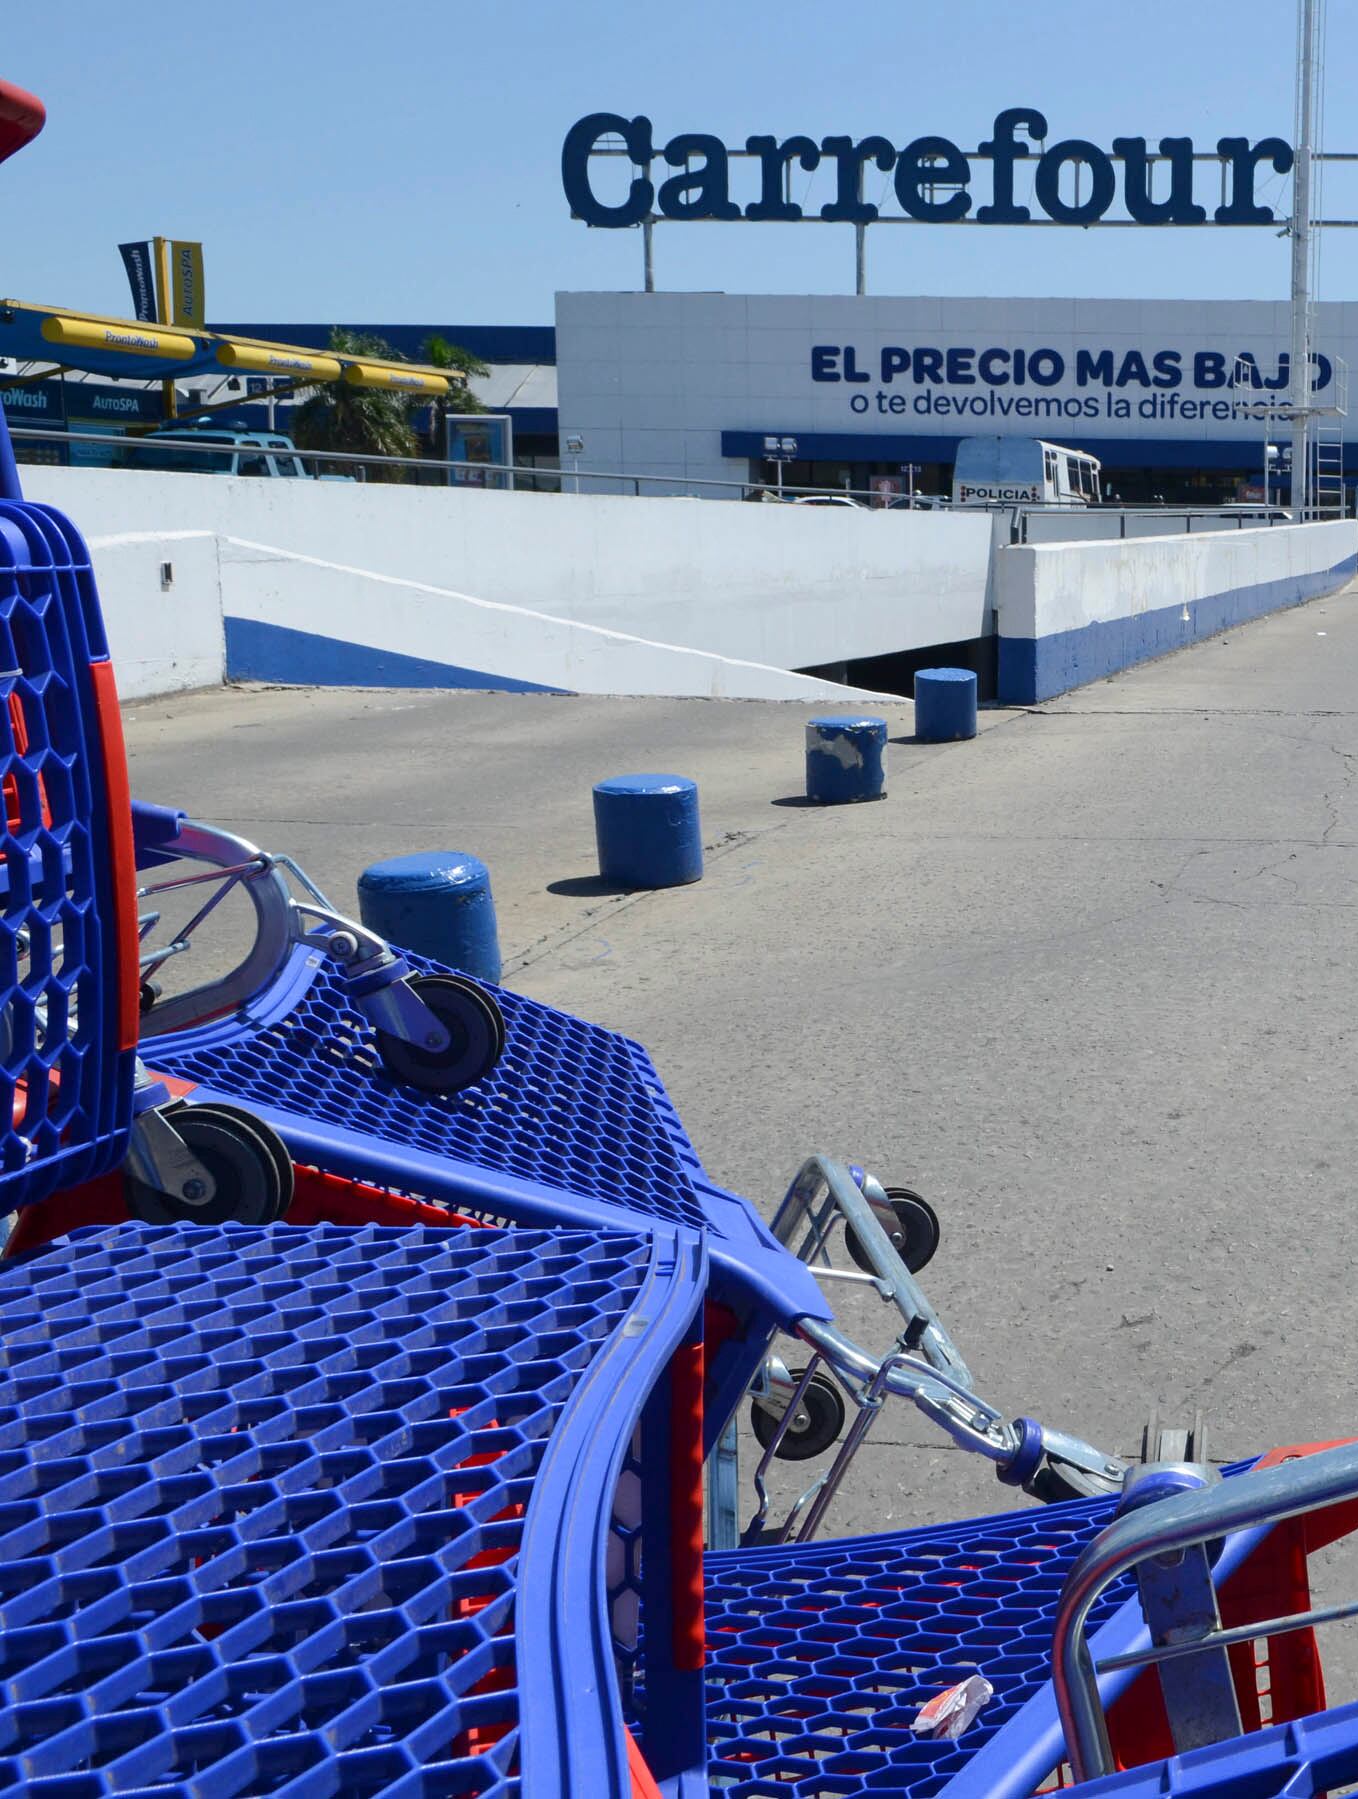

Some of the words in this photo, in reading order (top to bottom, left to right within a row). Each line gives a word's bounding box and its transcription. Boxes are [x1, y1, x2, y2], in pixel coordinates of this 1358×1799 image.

[562, 107, 1293, 228] Carrefour
[105, 330, 159, 349] ProntoWash
[811, 346, 870, 382] EL
[881, 347, 1065, 387] PRECIO
[1076, 350, 1182, 388] MAS
[850, 394, 869, 413] o
[876, 390, 906, 414] te
[913, 389, 1099, 417] devolvemos
[1107, 392, 1131, 418] la
[966, 487, 1030, 500] POLICIA
